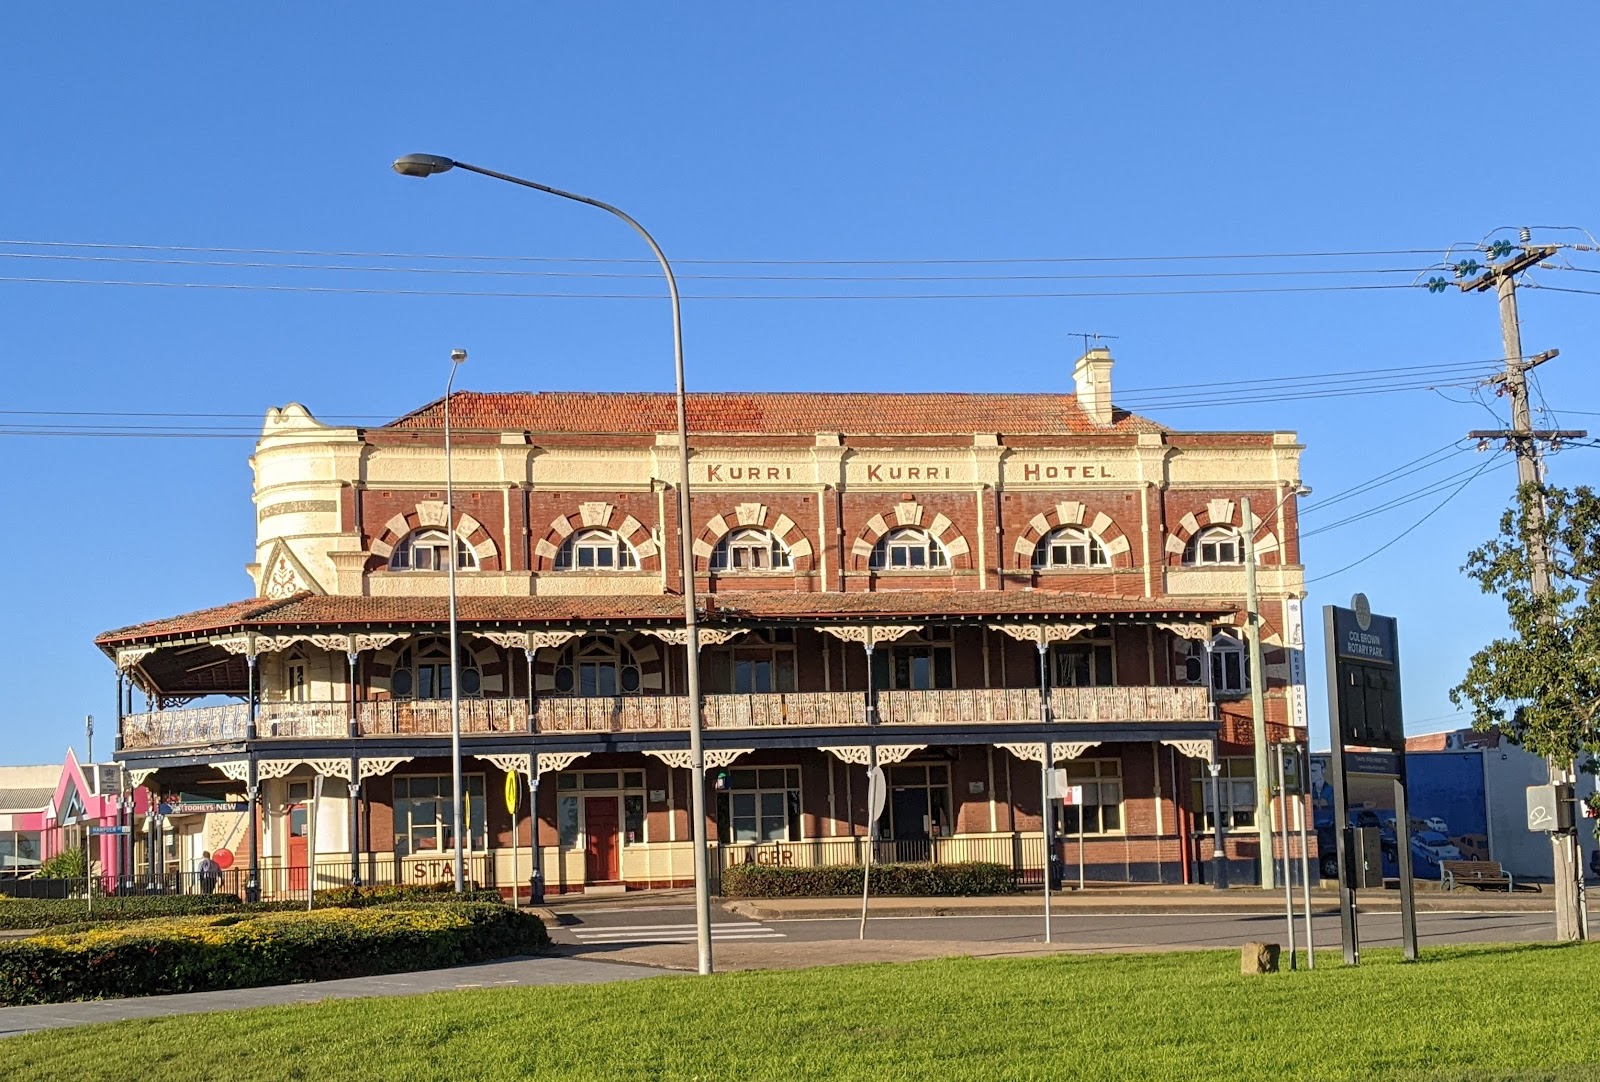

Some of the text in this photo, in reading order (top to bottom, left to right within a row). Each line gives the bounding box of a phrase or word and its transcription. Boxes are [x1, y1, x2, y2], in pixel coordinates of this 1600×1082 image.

[707, 464, 791, 482] KURRI
[867, 464, 950, 482] KURRI
[1360, 633, 1381, 646] BROWN
[1347, 642, 1383, 657] ROTARY PARK
[1294, 650, 1302, 722] RESTAURANT
[215, 803, 236, 811] NEW
